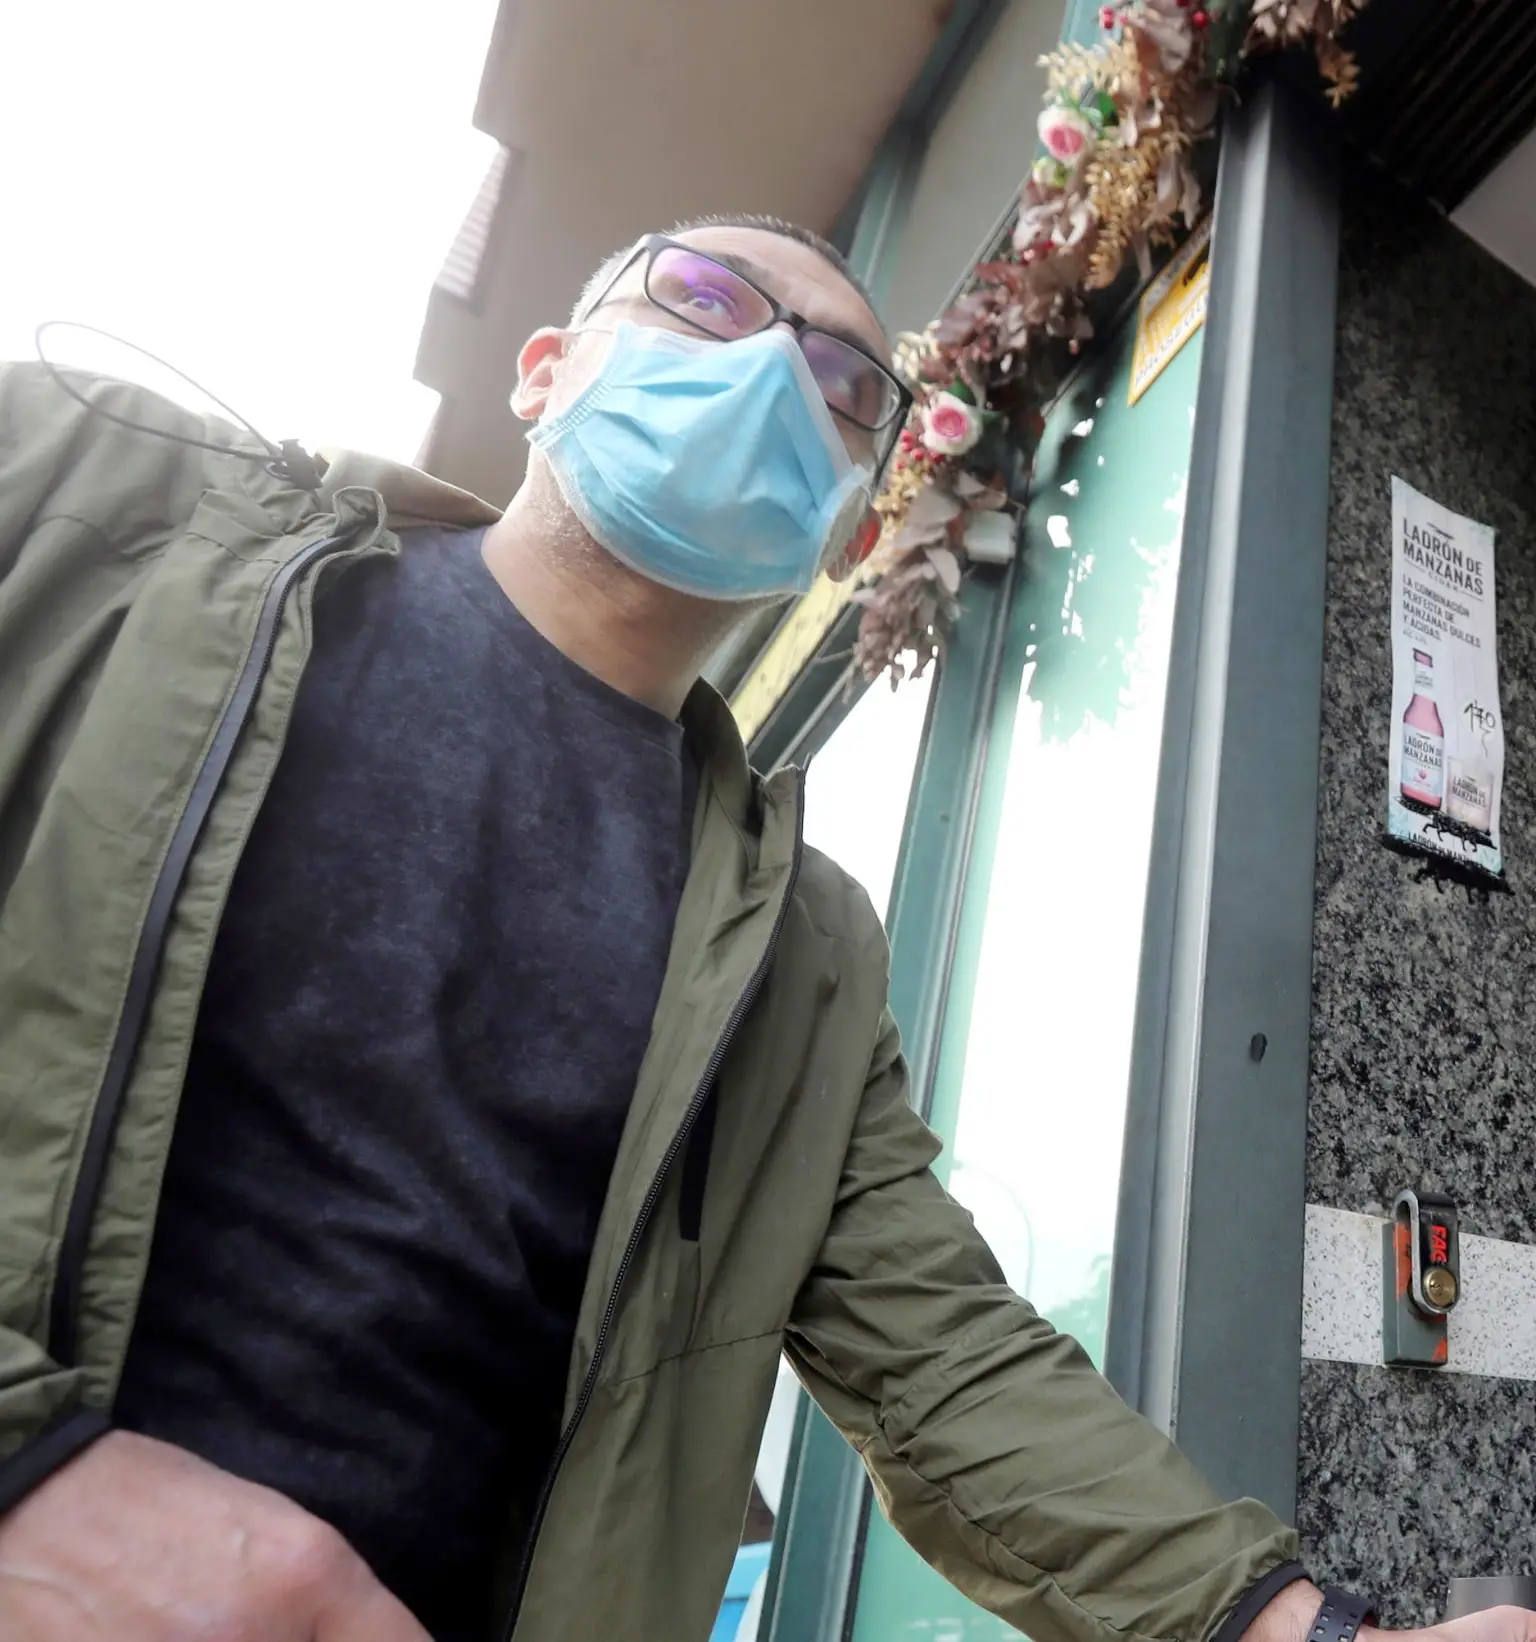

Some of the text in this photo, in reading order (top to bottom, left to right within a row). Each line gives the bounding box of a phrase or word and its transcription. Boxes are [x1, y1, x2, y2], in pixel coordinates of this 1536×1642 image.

[1403, 517, 1484, 577] LADRÓN DE
[1402, 572, 1412, 588] LA
[1403, 537, 1484, 595] MANZANAS
[1402, 586, 1443, 618] PERFECTA
[1402, 599, 1448, 632] MANZANAS
